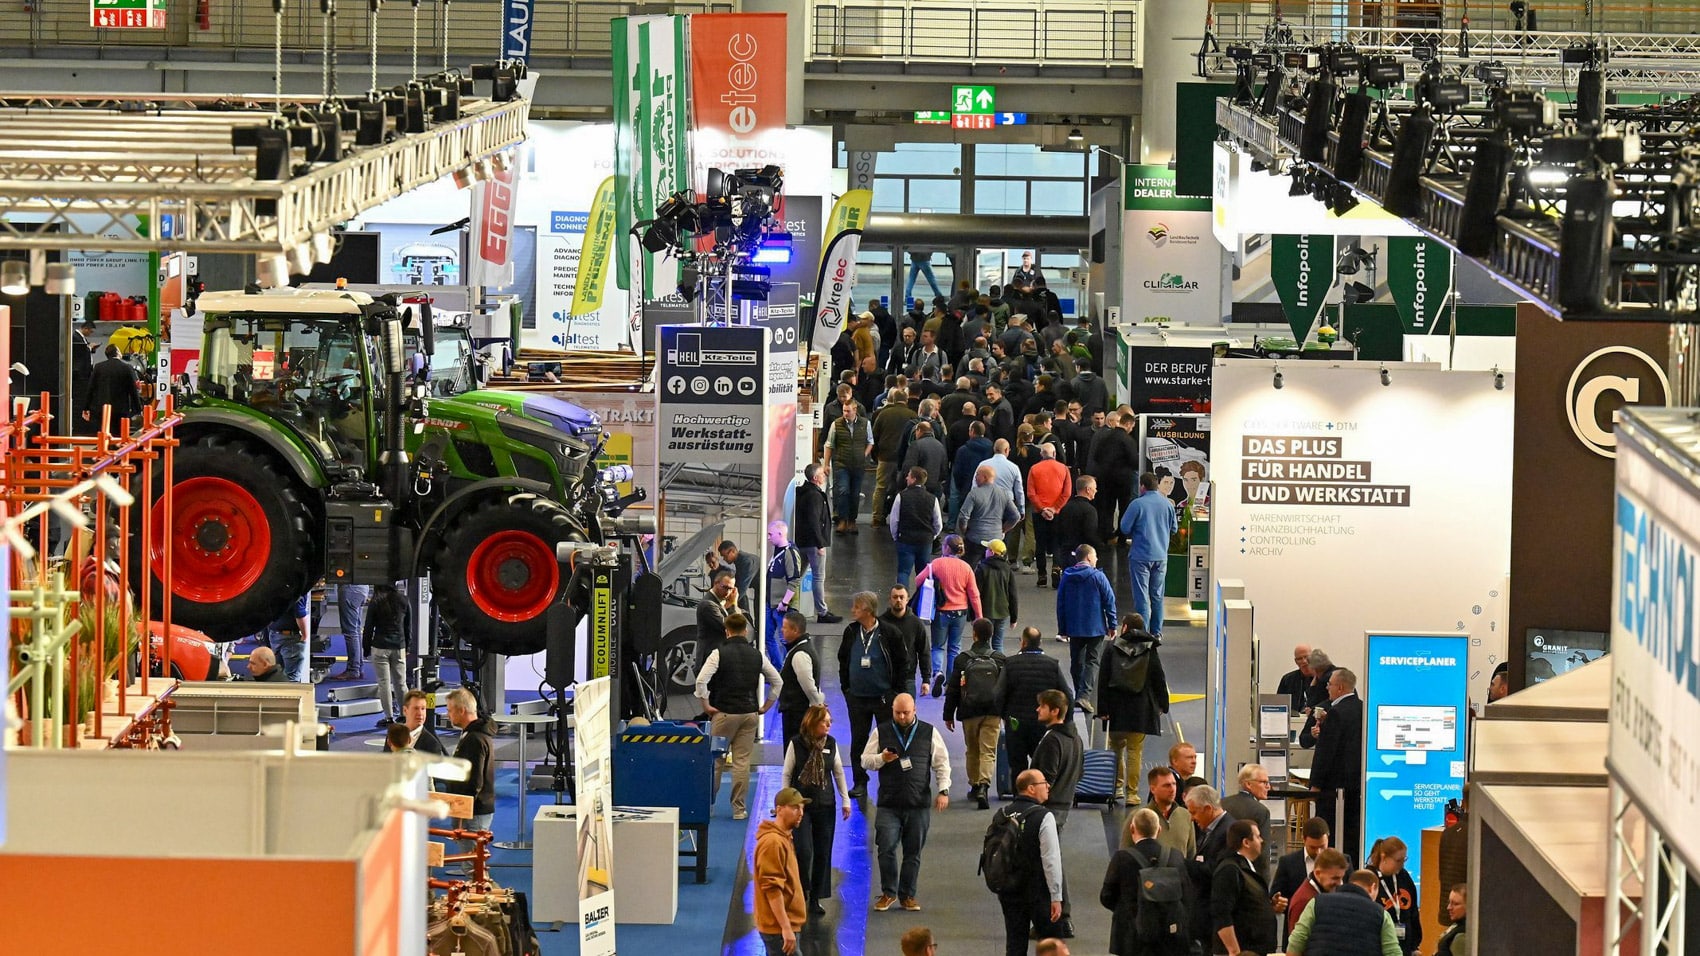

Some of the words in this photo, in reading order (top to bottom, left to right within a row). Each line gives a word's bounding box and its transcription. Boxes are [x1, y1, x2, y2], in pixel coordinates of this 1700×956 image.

[1134, 189, 1172, 198] DEALER
[159, 274, 165, 282] D
[827, 258, 847, 307] kretec
[1413, 242, 1427, 328] Infopoint
[74, 303, 81, 311] D
[161, 358, 168, 367] D
[679, 351, 698, 363] HEIL
[822, 361, 828, 370] E
[1145, 363, 1168, 373] DER
[1171, 363, 1209, 374] BERUF
[159, 383, 167, 391] D
[673, 414, 751, 427] Hochwertige
[813, 410, 819, 420] E
[1336, 422, 1358, 431] DTM
[671, 427, 752, 440] Werkstatt-
[1156, 431, 1205, 439] AUSBILDUNG
[668, 439, 754, 453] ausrüstung
[1248, 438, 1287, 455] DAS
[1290, 440, 1338, 456] PLUS
[1247, 459, 1284, 478] FÜR
[1289, 463, 1367, 480] HANDEL
[1247, 486, 1291, 502] UND
[1295, 487, 1406, 504] WERKSTATT
[1250, 513, 1342, 524] WARENWIRTSCHAFT
[1250, 525, 1356, 536] FINANZBUCHHALTUNG
[1249, 536, 1317, 546] CONTROLLING
[1249, 547, 1284, 556] ARCHIV
[1196, 556, 1203, 567] E
[1195, 578, 1202, 589] E
[1542, 644, 1568, 652] GRANIT
[1379, 656, 1457, 666] SERVICEPLANER
